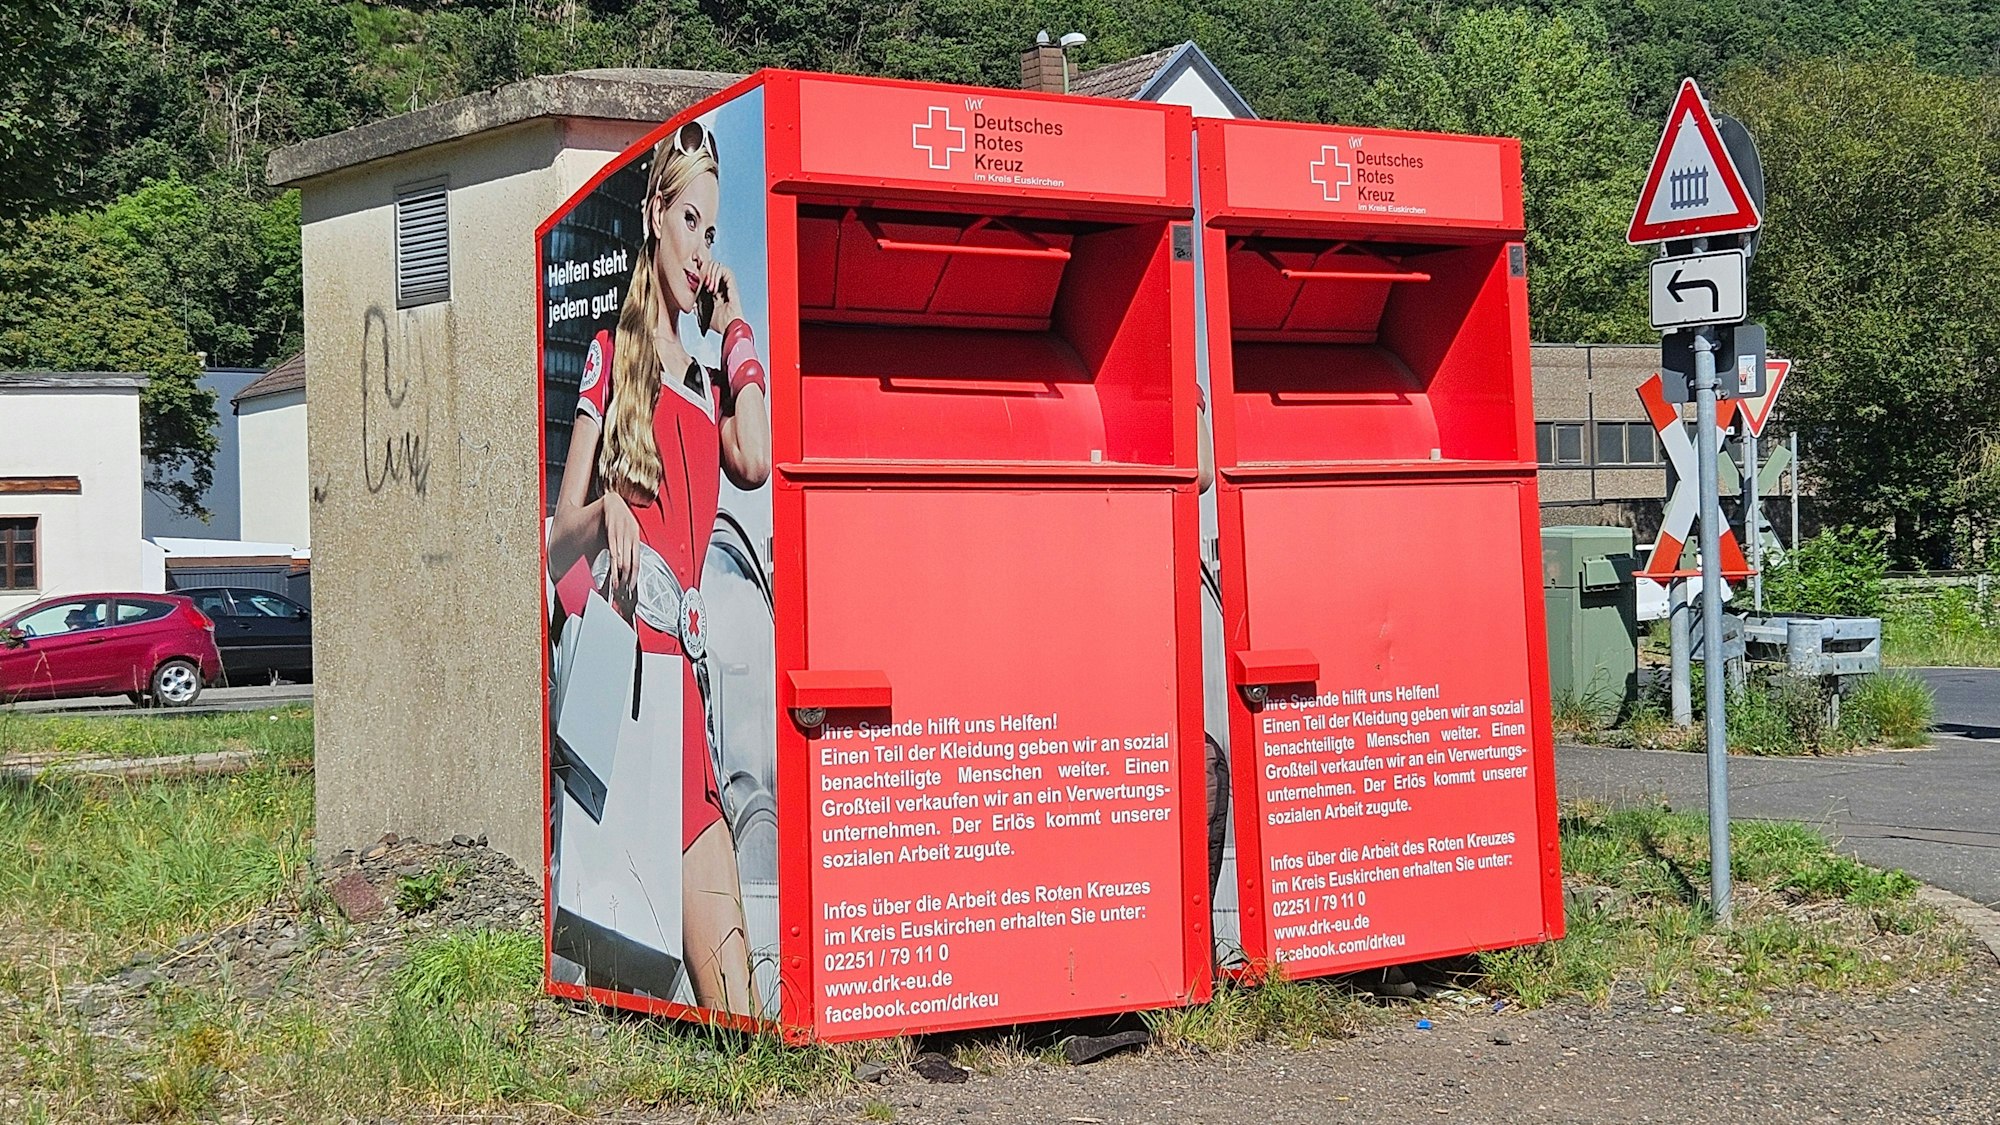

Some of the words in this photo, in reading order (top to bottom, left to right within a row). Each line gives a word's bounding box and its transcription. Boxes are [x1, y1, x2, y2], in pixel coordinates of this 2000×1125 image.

[965, 97, 984, 111] Ihr
[974, 113, 1064, 136] Deutsches
[974, 133, 1024, 153] Rotes
[1348, 136, 1364, 149] Ihr
[974, 153, 1024, 173] Kreuz
[1356, 150, 1424, 169] Deutsches
[988, 173, 1012, 184] Kreis
[1014, 175, 1065, 187] Euskirchen
[1357, 168, 1395, 185] Rotes
[1357, 186, 1395, 203] Kreuz
[1368, 203, 1387, 213] Kreis
[1388, 204, 1427, 215] Euskirchen
[548, 260, 589, 288] Helfen
[592, 249, 628, 279] steht
[548, 297, 588, 328] jedem
[592, 286, 618, 320] gut!
[1262, 697, 1287, 711] Ihre
[1290, 692, 1339, 712] Spende
[1342, 689, 1367, 705] hilft
[1369, 690, 1393, 703] uns
[1395, 684, 1440, 701] Helfen!
[821, 722, 853, 740] Ihre
[859, 720, 923, 742] Spende
[928, 717, 960, 735] hilft
[965, 718, 995, 733] uns
[1000, 713, 1057, 731] Helfen!
[1262, 718, 1300, 734] Einen
[1303, 714, 1326, 730] Teil
[1328, 714, 1350, 729] der
[1352, 709, 1408, 727] Kleidung
[1411, 706, 1449, 725] geben
[1451, 704, 1470, 719] wir
[1472, 705, 1487, 718] an
[1490, 699, 1524, 716] sozial
[821, 748, 870, 766] Einen
[874, 745, 904, 763] Teil
[908, 744, 936, 761] der
[940, 741, 1014, 760] Kleidung
[1018, 738, 1069, 759] geben
[1073, 736, 1097, 753] wir
[1101, 737, 1120, 751] an
[1123, 733, 1169, 750] sozial
[1264, 735, 1355, 757] benachteiligte
[1366, 730, 1430, 748] Menschen
[1441, 725, 1481, 742] weiter.
[1491, 722, 1525, 737] Einen
[821, 770, 942, 791] benachteiligte
[958, 764, 1042, 784] Menschen
[1058, 761, 1110, 777] weiter.
[1125, 757, 1169, 774] Einen
[1265, 761, 1318, 780] Großteil
[1321, 755, 1384, 774] verkaufen
[1386, 753, 1405, 769] wir
[1408, 754, 1424, 767] an
[1426, 749, 1445, 764] ein
[1448, 745, 1527, 762] Verwertungs-
[1266, 783, 1356, 803] unternehmen.
[1363, 777, 1386, 793] Der
[1393, 773, 1426, 790] Erlös
[1433, 769, 1476, 786] kommt
[1482, 765, 1528, 782] unserer
[822, 796, 890, 817] Großteil
[895, 792, 978, 812] verkaufen
[983, 789, 1009, 807] wir
[1013, 791, 1033, 805] an
[1037, 787, 1062, 804] ein
[1066, 783, 1171, 802] Verwertungs-
[1267, 806, 1322, 826] sozialen
[1324, 801, 1363, 819] Arbeit
[1366, 797, 1412, 817] zugute.
[822, 821, 941, 843] unternehmen.
[952, 817, 982, 834] Der
[992, 813, 1035, 831] Erlös
[1046, 810, 1101, 828] kommt
[1111, 807, 1171, 824] unserer
[822, 848, 894, 869] sozialen
[898, 843, 950, 863] Arbeit
[954, 840, 1015, 862] zugute.
[1270, 854, 1304, 872] Infos
[1307, 851, 1336, 867] über
[1339, 847, 1358, 863] die
[1361, 842, 1399, 860] Arbeit
[1402, 840, 1424, 856] des
[1427, 836, 1464, 853] Roten
[1467, 831, 1515, 848] Kreuzes
[1271, 879, 1288, 894] im
[1291, 874, 1326, 892] Kreis
[1328, 866, 1400, 887] Euskirchen
[1402, 860, 1453, 878] erhalten
[1455, 856, 1475, 872] Sie
[1478, 854, 1513, 869] unter:
[823, 901, 868, 920] Infos
[872, 899, 912, 917] über
[915, 895, 942, 912] die
[946, 890, 997, 910] Arbeit
[1001, 889, 1030, 906] des
[1035, 884, 1083, 903] Roten
[1087, 881, 1151, 899] Kreuzes
[1272, 897, 1311, 917] 02251
[1314, 896, 1319, 912] /
[1322, 894, 1337, 911] 79
[1341, 892, 1354, 908] 11
[1357, 890, 1366, 906] 0
[824, 929, 846, 946] im
[851, 924, 896, 943] Kreis
[901, 917, 996, 939] Euskirchen
[1000, 911, 1066, 931] erhalten
[1070, 907, 1096, 925] Sie
[1100, 905, 1146, 922] unter:
[1274, 913, 1370, 940] www.drk-eu.de
[824, 950, 874, 972] 02251
[879, 949, 886, 967] /
[890, 947, 911, 966] 79
[915, 945, 933, 963] 11
[938, 944, 949, 962] 0
[1275, 932, 1405, 963] facebook.com/drkeu
[825, 970, 953, 998] www.drk-eu.de
[825, 992, 999, 1024] facebook.com/drkeu
